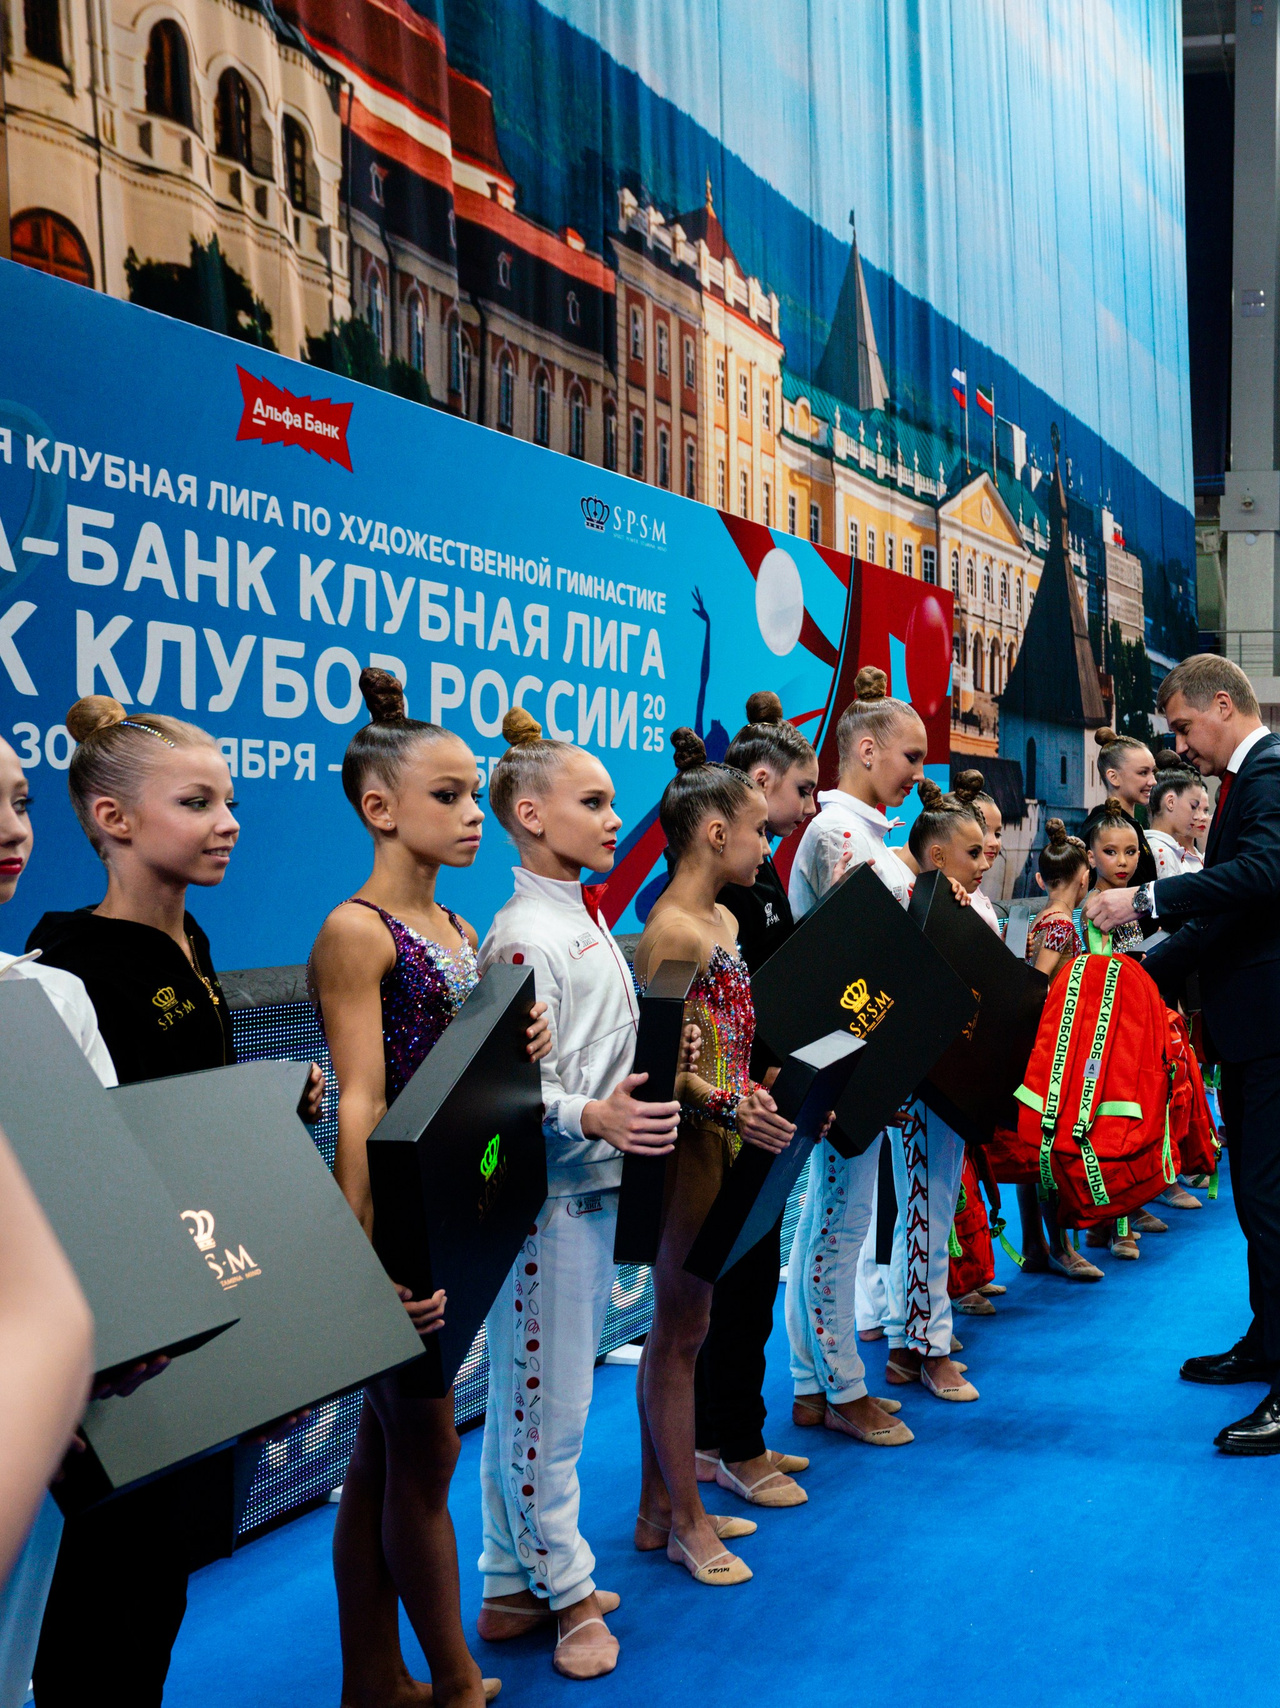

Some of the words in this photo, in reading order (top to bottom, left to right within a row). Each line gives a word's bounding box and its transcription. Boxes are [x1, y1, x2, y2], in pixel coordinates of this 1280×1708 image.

[252, 397, 302, 430] Альфа
[304, 412, 340, 440] Банк
[26, 433, 197, 508] КЛУБНАЯ
[207, 480, 284, 527] ЛИГА
[292, 501, 331, 536] ПО
[339, 512, 551, 590] ХУДОЖЕСТВЕННОЙ
[556, 567, 666, 614] ГИМНАСТИКЕ
[300, 553, 549, 660] КЛУБНАЯ
[563, 611, 666, 680] ЛИГА
[430, 661, 638, 750] РОССИИ
[643, 693, 666, 721] 20
[12, 721, 77, 771] 30
[216, 737, 316, 781] ЯБРЯ
[642, 725, 665, 753] 25
[1067, 986, 1079, 998] И
[1101, 959, 1120, 1010] УМНЫХ
[1051, 999, 1076, 1085] СВОБОДНЫХ
[1099, 1012, 1110, 1023] И
